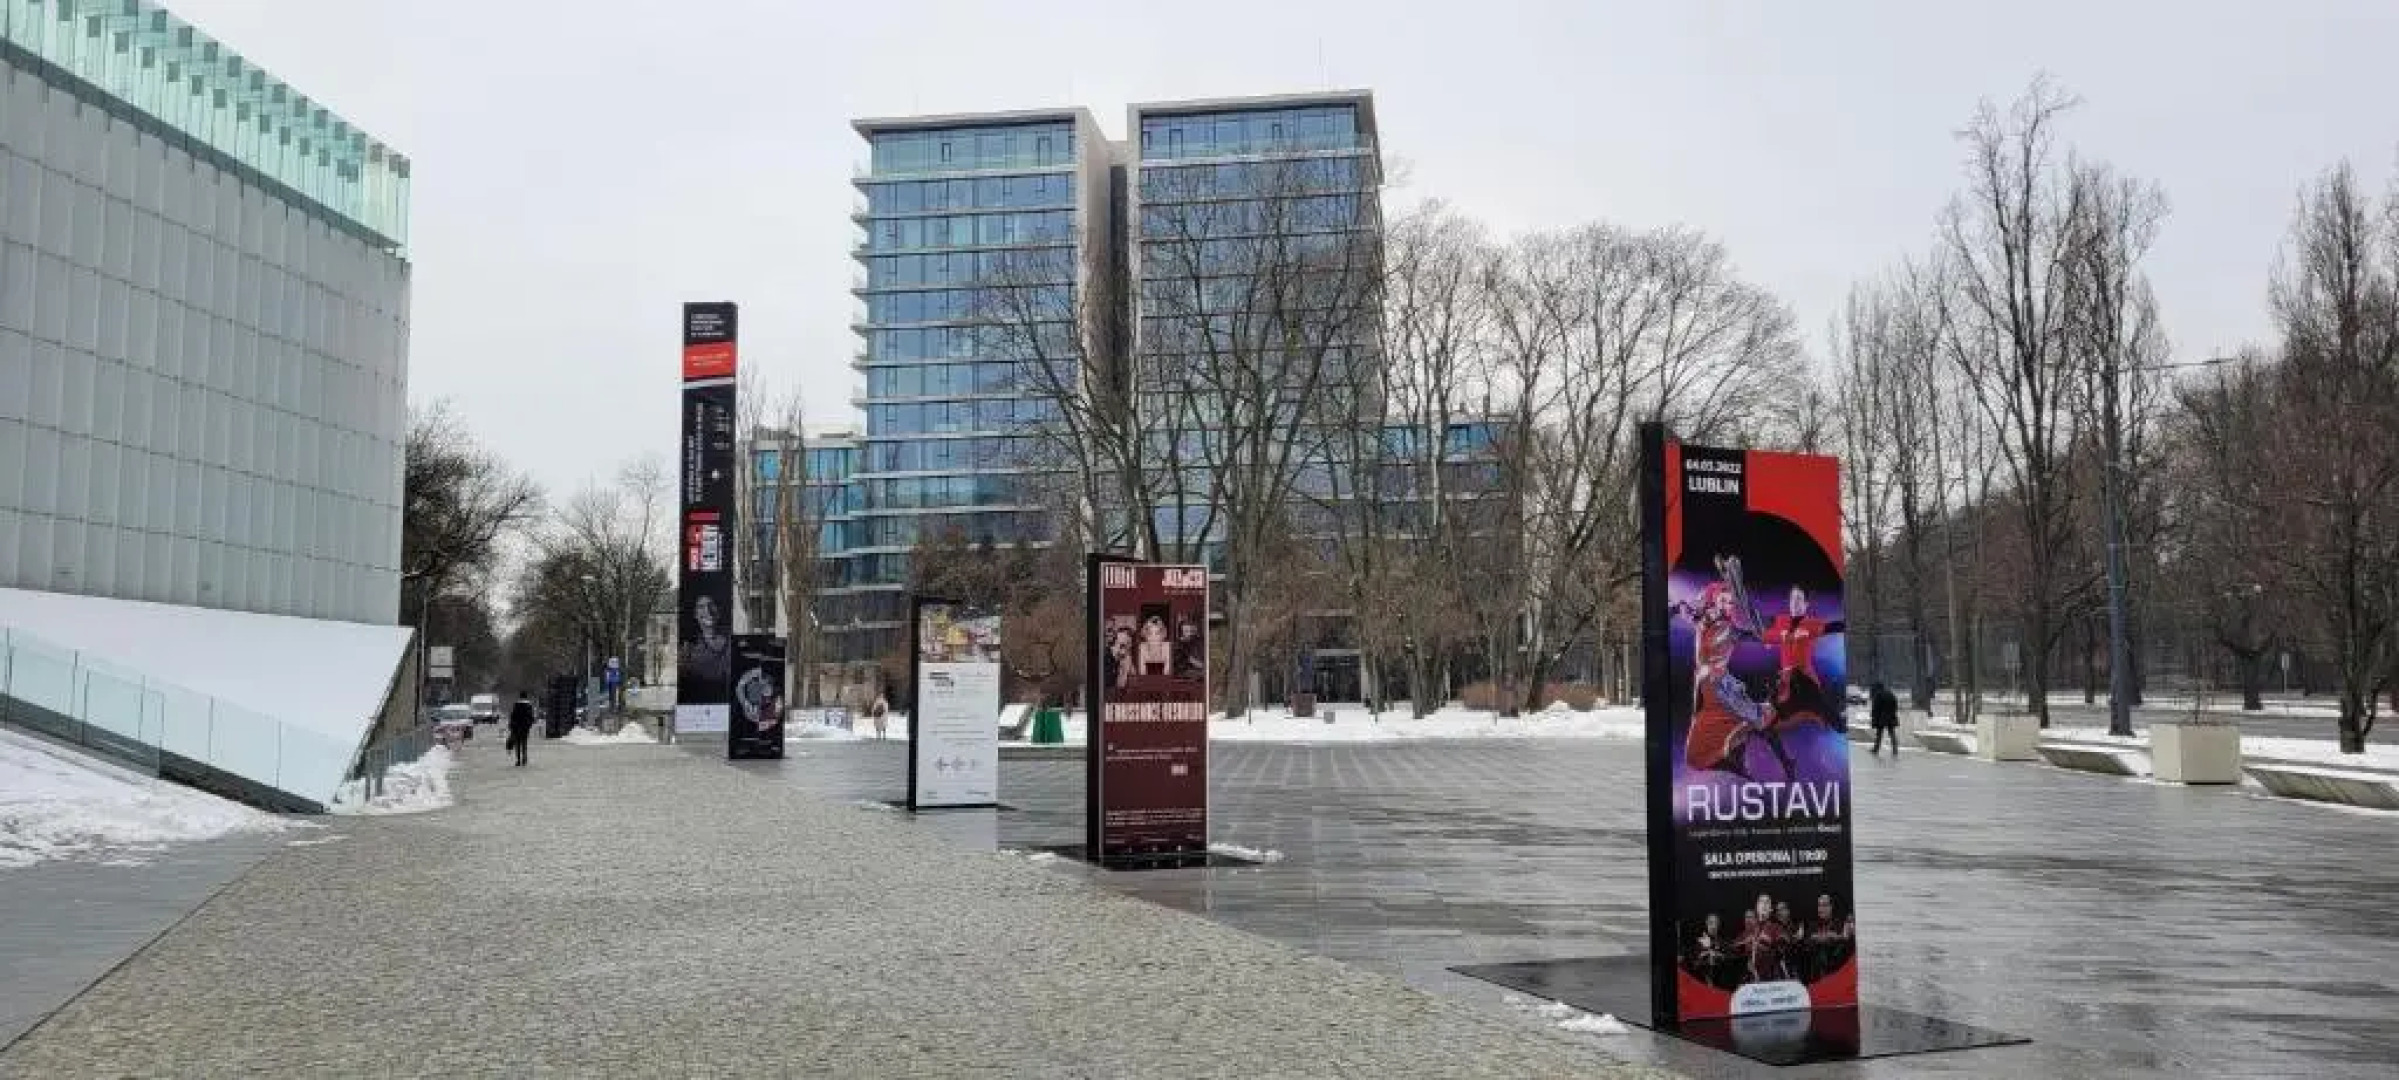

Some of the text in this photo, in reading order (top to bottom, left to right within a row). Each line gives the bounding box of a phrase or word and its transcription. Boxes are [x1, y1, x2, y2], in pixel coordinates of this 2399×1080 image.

[1688, 476, 1739, 494] LUBLIN
[1688, 782, 1840, 821] RUSTAVI
[1704, 852, 1734, 866] SALA
